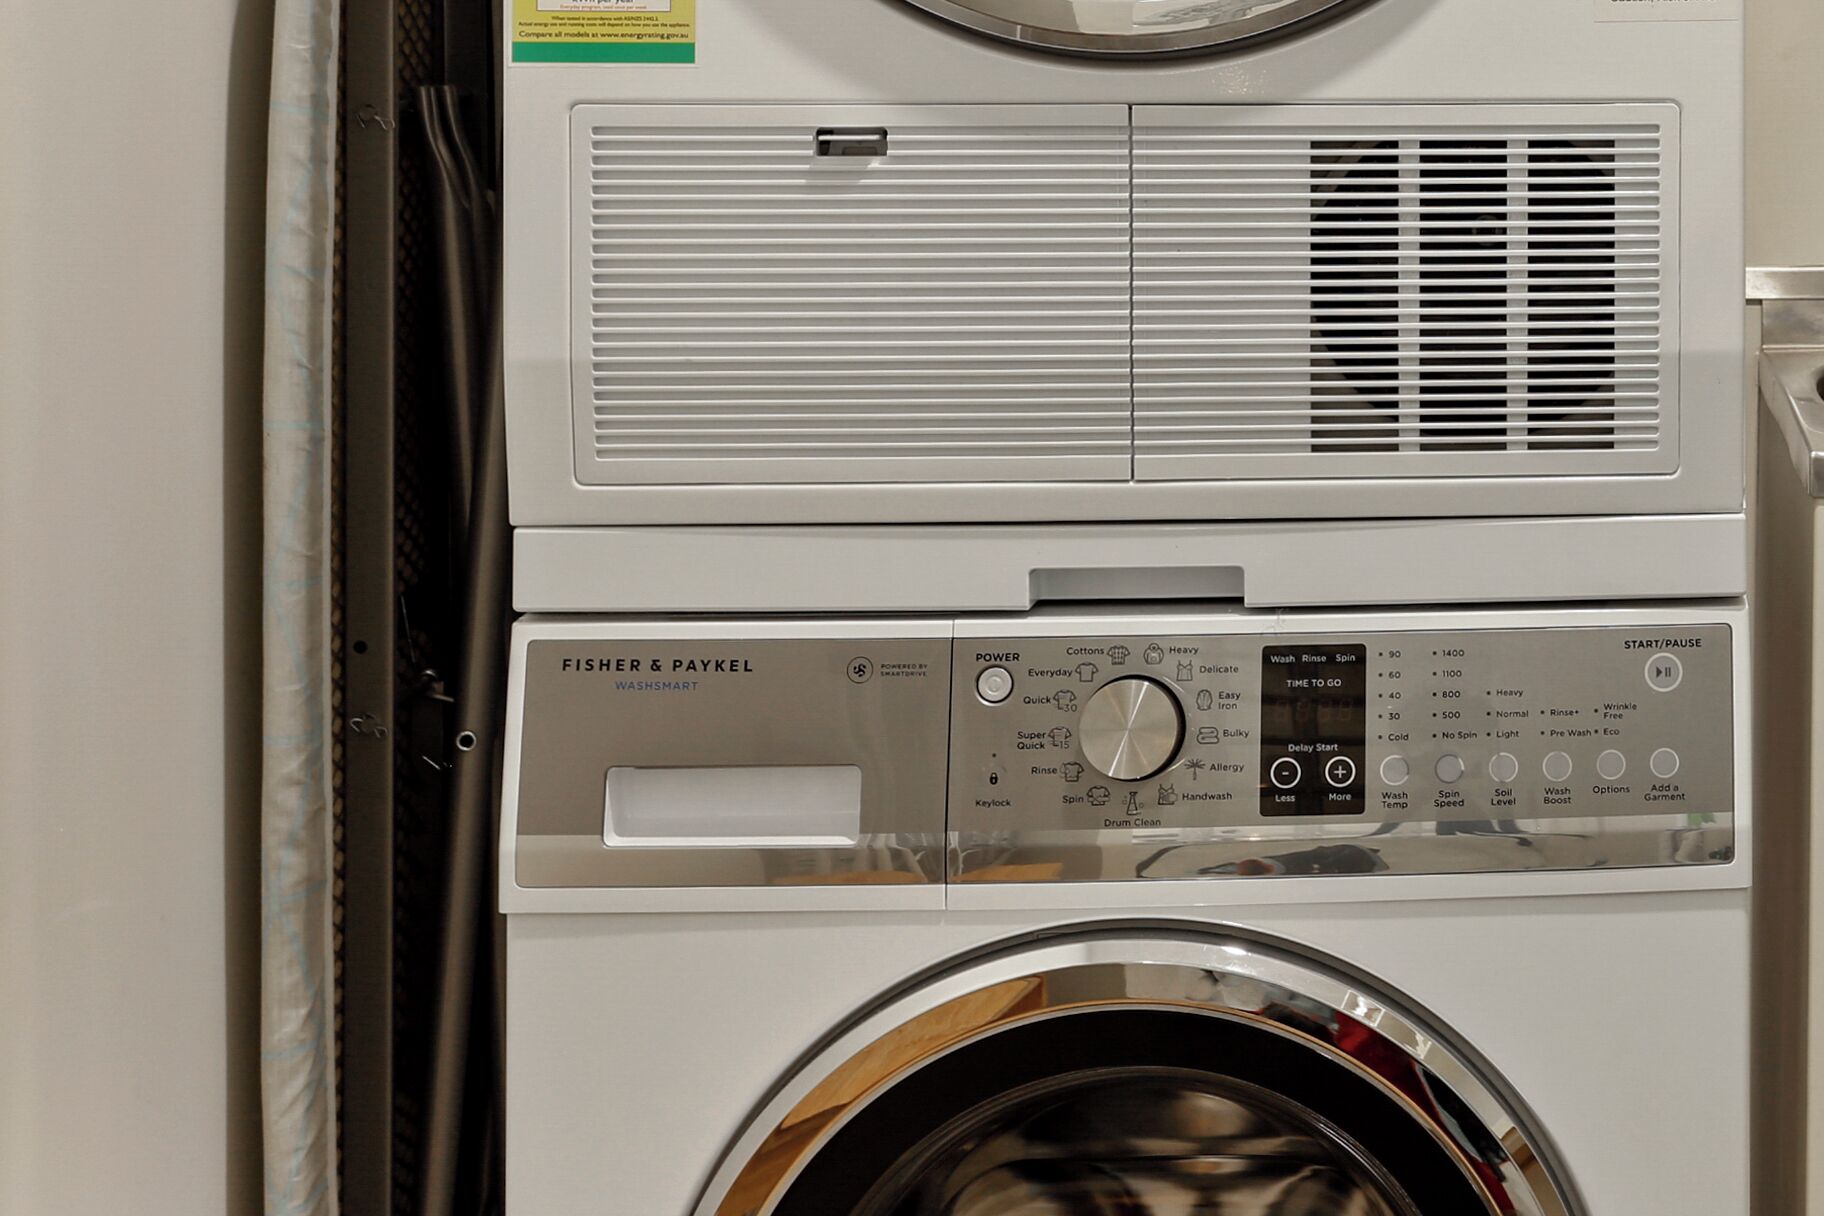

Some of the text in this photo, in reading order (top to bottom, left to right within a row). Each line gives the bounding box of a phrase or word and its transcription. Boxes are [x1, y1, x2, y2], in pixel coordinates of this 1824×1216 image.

[518, 30, 553, 39] Compare
[1624, 638, 1702, 650] START/PAUSE
[1066, 646, 1104, 656] Cottons
[1169, 646, 1199, 655] Heavy
[1388, 650, 1401, 658] 90
[1442, 649, 1464, 657] 1400
[975, 652, 1021, 663] POWER
[1270, 655, 1296, 663] Wash
[1302, 654, 1327, 663] Rinse
[1335, 653, 1356, 663] Spin
[561, 657, 753, 673] FISHER & PAYKEL
[1199, 665, 1239, 674] Delicate
[1028, 669, 1073, 679] Everyday
[1388, 671, 1401, 679] 60
[1442, 670, 1462, 678] 1100
[615, 680, 698, 692] WASHSMART
[1286, 679, 1341, 688] TIME TO GO
[1219, 691, 1241, 701] Easy
[1442, 690, 1461, 698] 800
[1496, 689, 1524, 698] Heavy
[1023, 696, 1052, 706] Quick
[1218, 701, 1238, 710] Iron
[1603, 702, 1637, 711] Wrinkle
[1388, 712, 1400, 720] 30
[1442, 711, 1461, 719] 500
[1496, 710, 1529, 718] Normal
[1550, 708, 1580, 717] Rinse+
[1603, 711, 1624, 720] Free
[1017, 731, 1047, 742] Super
[1223, 729, 1250, 739] Bulky
[1442, 731, 1478, 740] No Spin
[1496, 730, 1520, 739] Light
[1550, 728, 1592, 737] Pre Wash
[1603, 728, 1620, 736] Eco
[1388, 733, 1409, 742] Cold
[1017, 741, 1045, 751] Quick
[1288, 743, 1338, 753] Delay Start
[1031, 766, 1058, 775] Rinse
[1209, 763, 1244, 773] Allergy
[1495, 788, 1513, 797] Soil
[1544, 787, 1571, 796] Wash
[1592, 785, 1631, 796] Options
[1651, 784, 1671, 793] Add
[1182, 792, 1232, 801] Handwash
[1275, 794, 1295, 803] Less
[1328, 793, 1352, 802] More
[1381, 791, 1408, 800] Wash
[1438, 790, 1460, 798] Spin
[1644, 793, 1686, 802] Garment
[975, 797, 1011, 809] Keylock
[1062, 795, 1084, 805] Spin
[1433, 799, 1464, 808] Speed
[1490, 797, 1516, 806] Level
[1544, 796, 1572, 805] Boost
[1382, 801, 1408, 809] Temp
[1104, 818, 1161, 827] Drum Clean
